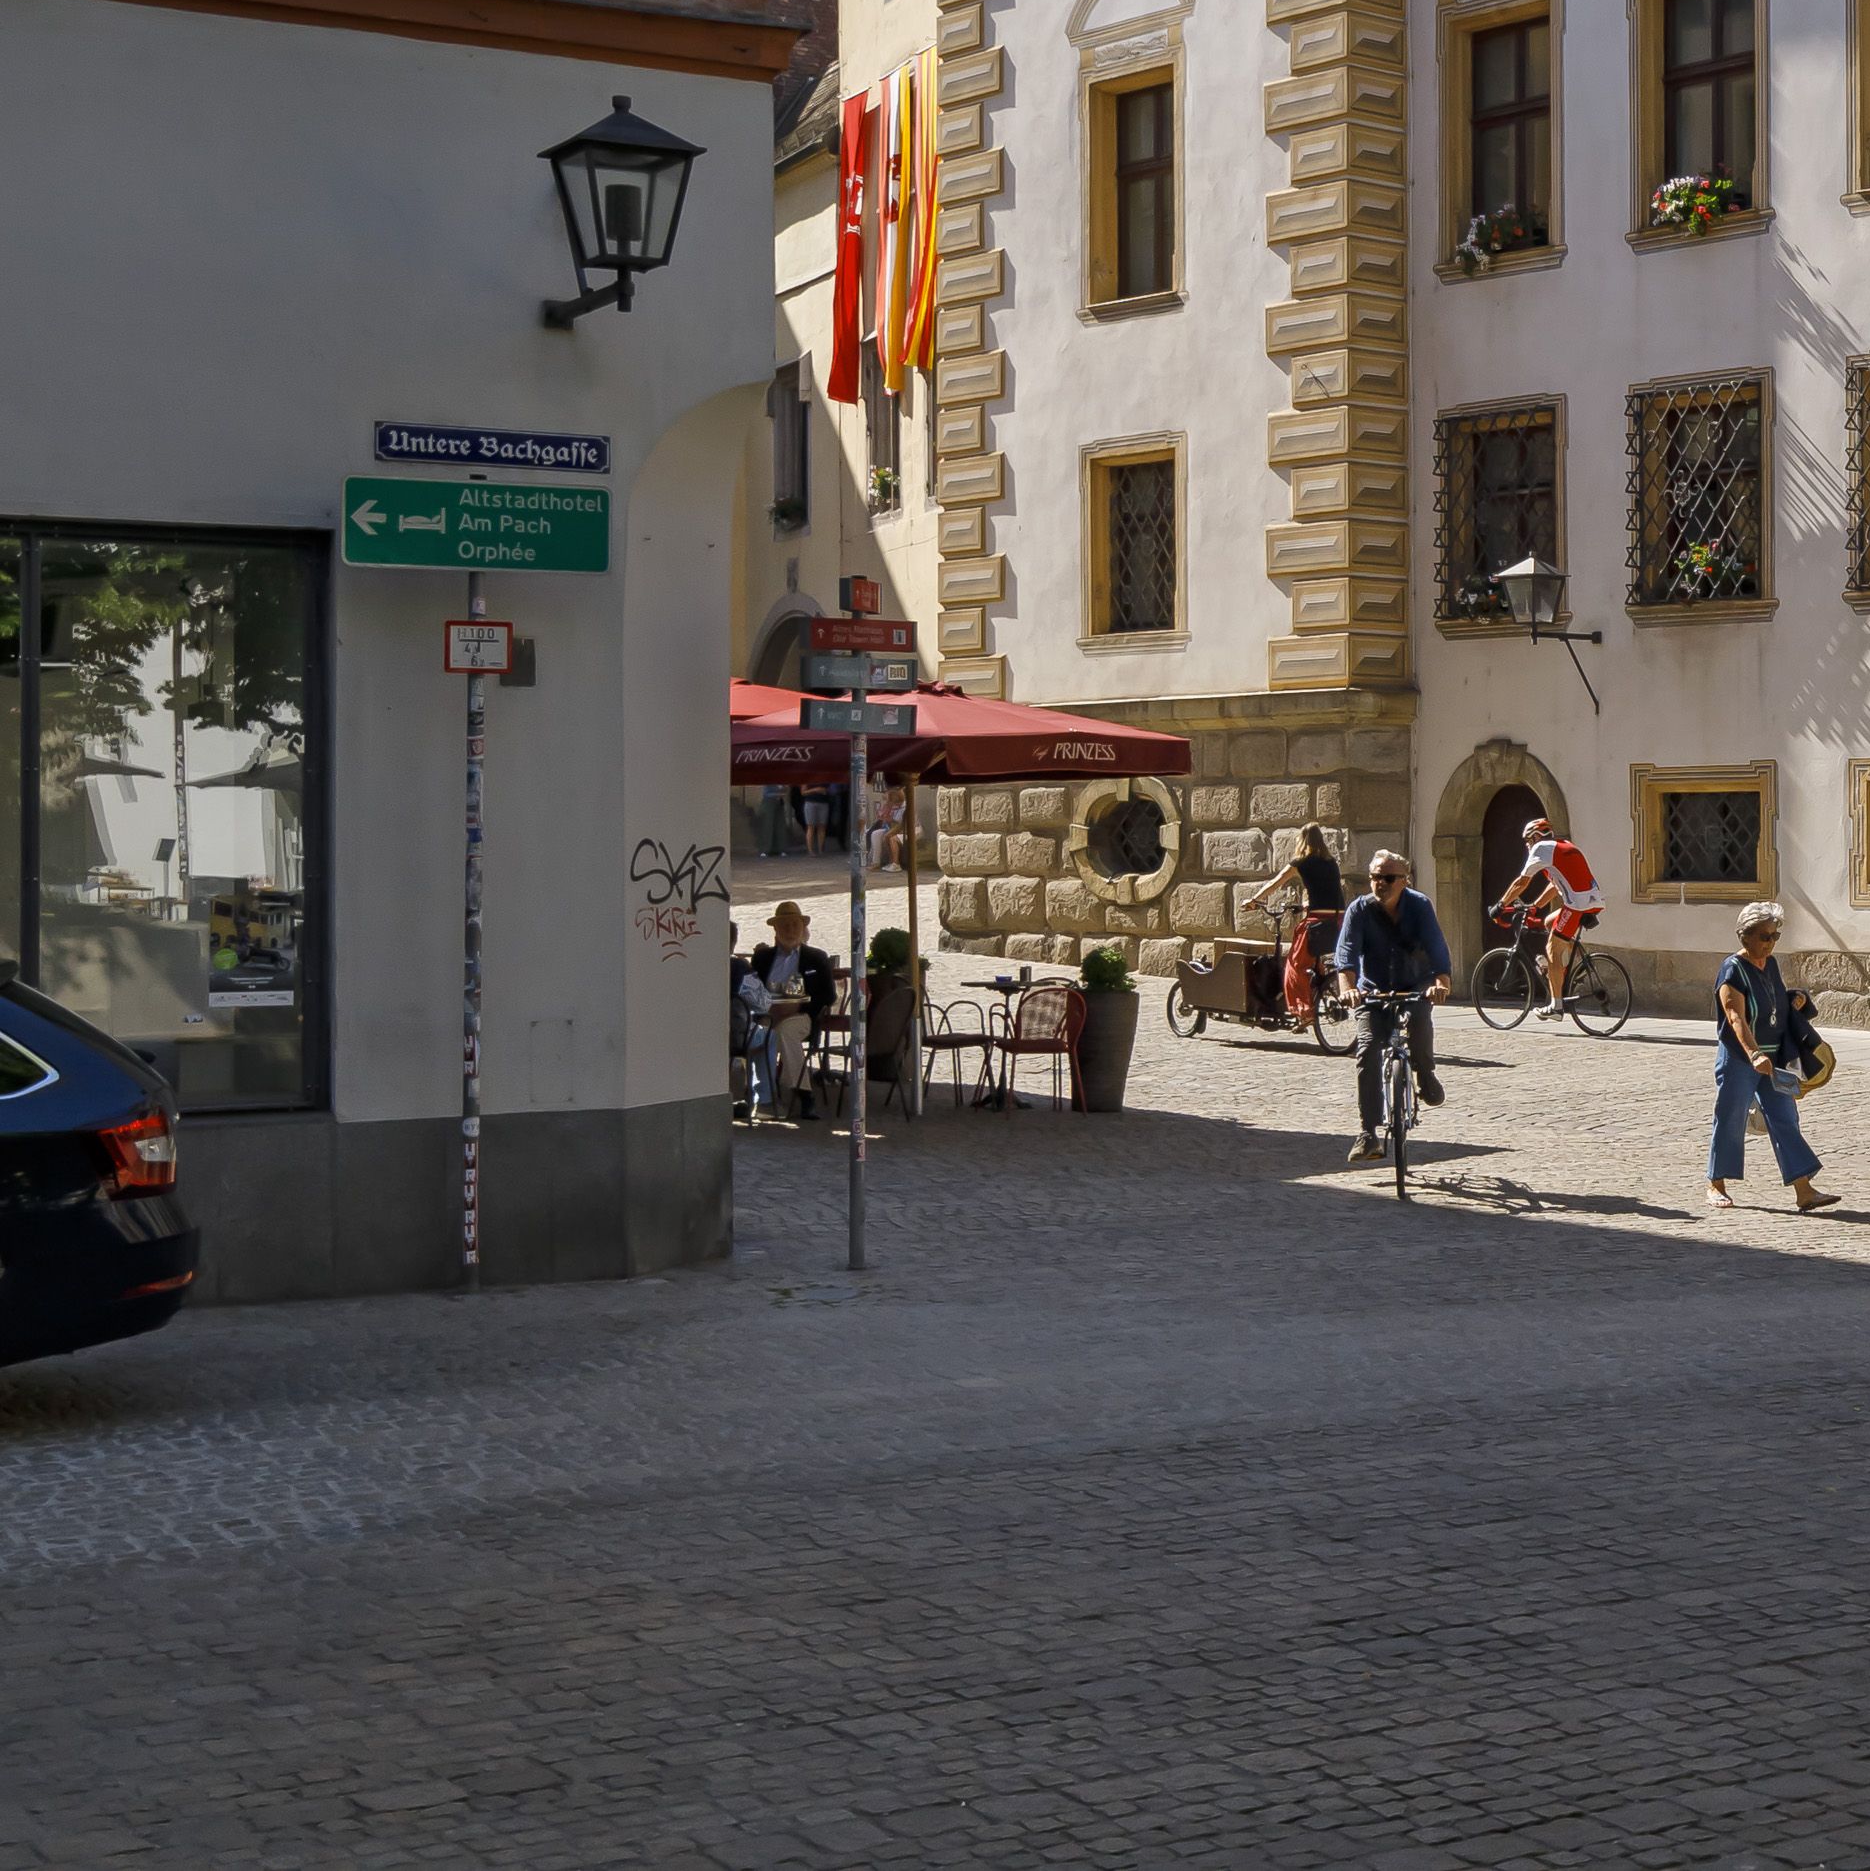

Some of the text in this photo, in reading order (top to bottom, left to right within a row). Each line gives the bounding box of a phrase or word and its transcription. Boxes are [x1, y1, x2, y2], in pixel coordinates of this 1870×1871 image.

[387, 429, 471, 456] Untere
[458, 488, 603, 513] Altstadthotel
[458, 513, 552, 535] Am Pach
[458, 540, 537, 563] Orphée
[735, 746, 815, 763] PRINZESS
[1053, 742, 1117, 761] PRINZESS
